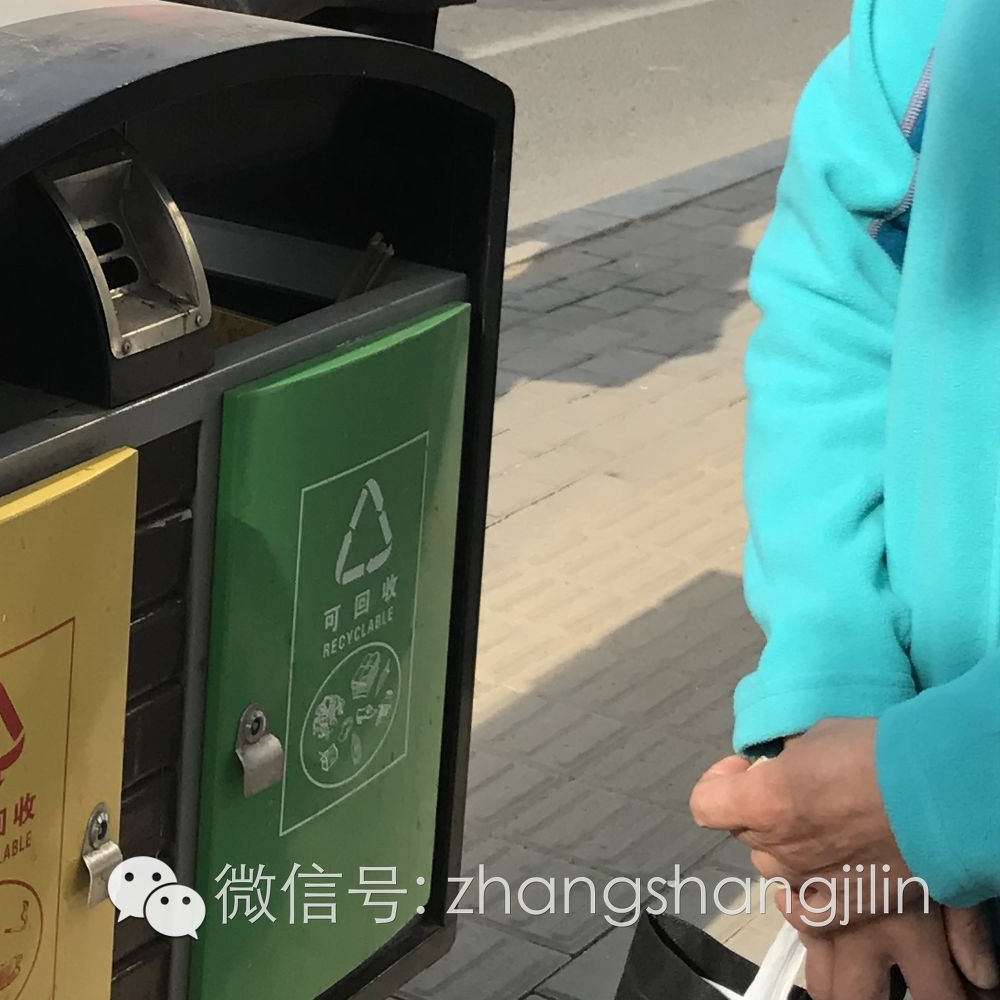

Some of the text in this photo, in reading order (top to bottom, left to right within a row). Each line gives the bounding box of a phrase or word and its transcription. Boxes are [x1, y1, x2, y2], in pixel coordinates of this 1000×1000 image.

[323, 573, 399, 633] 可回收
[322, 605, 394, 659] RECYCLABLE
